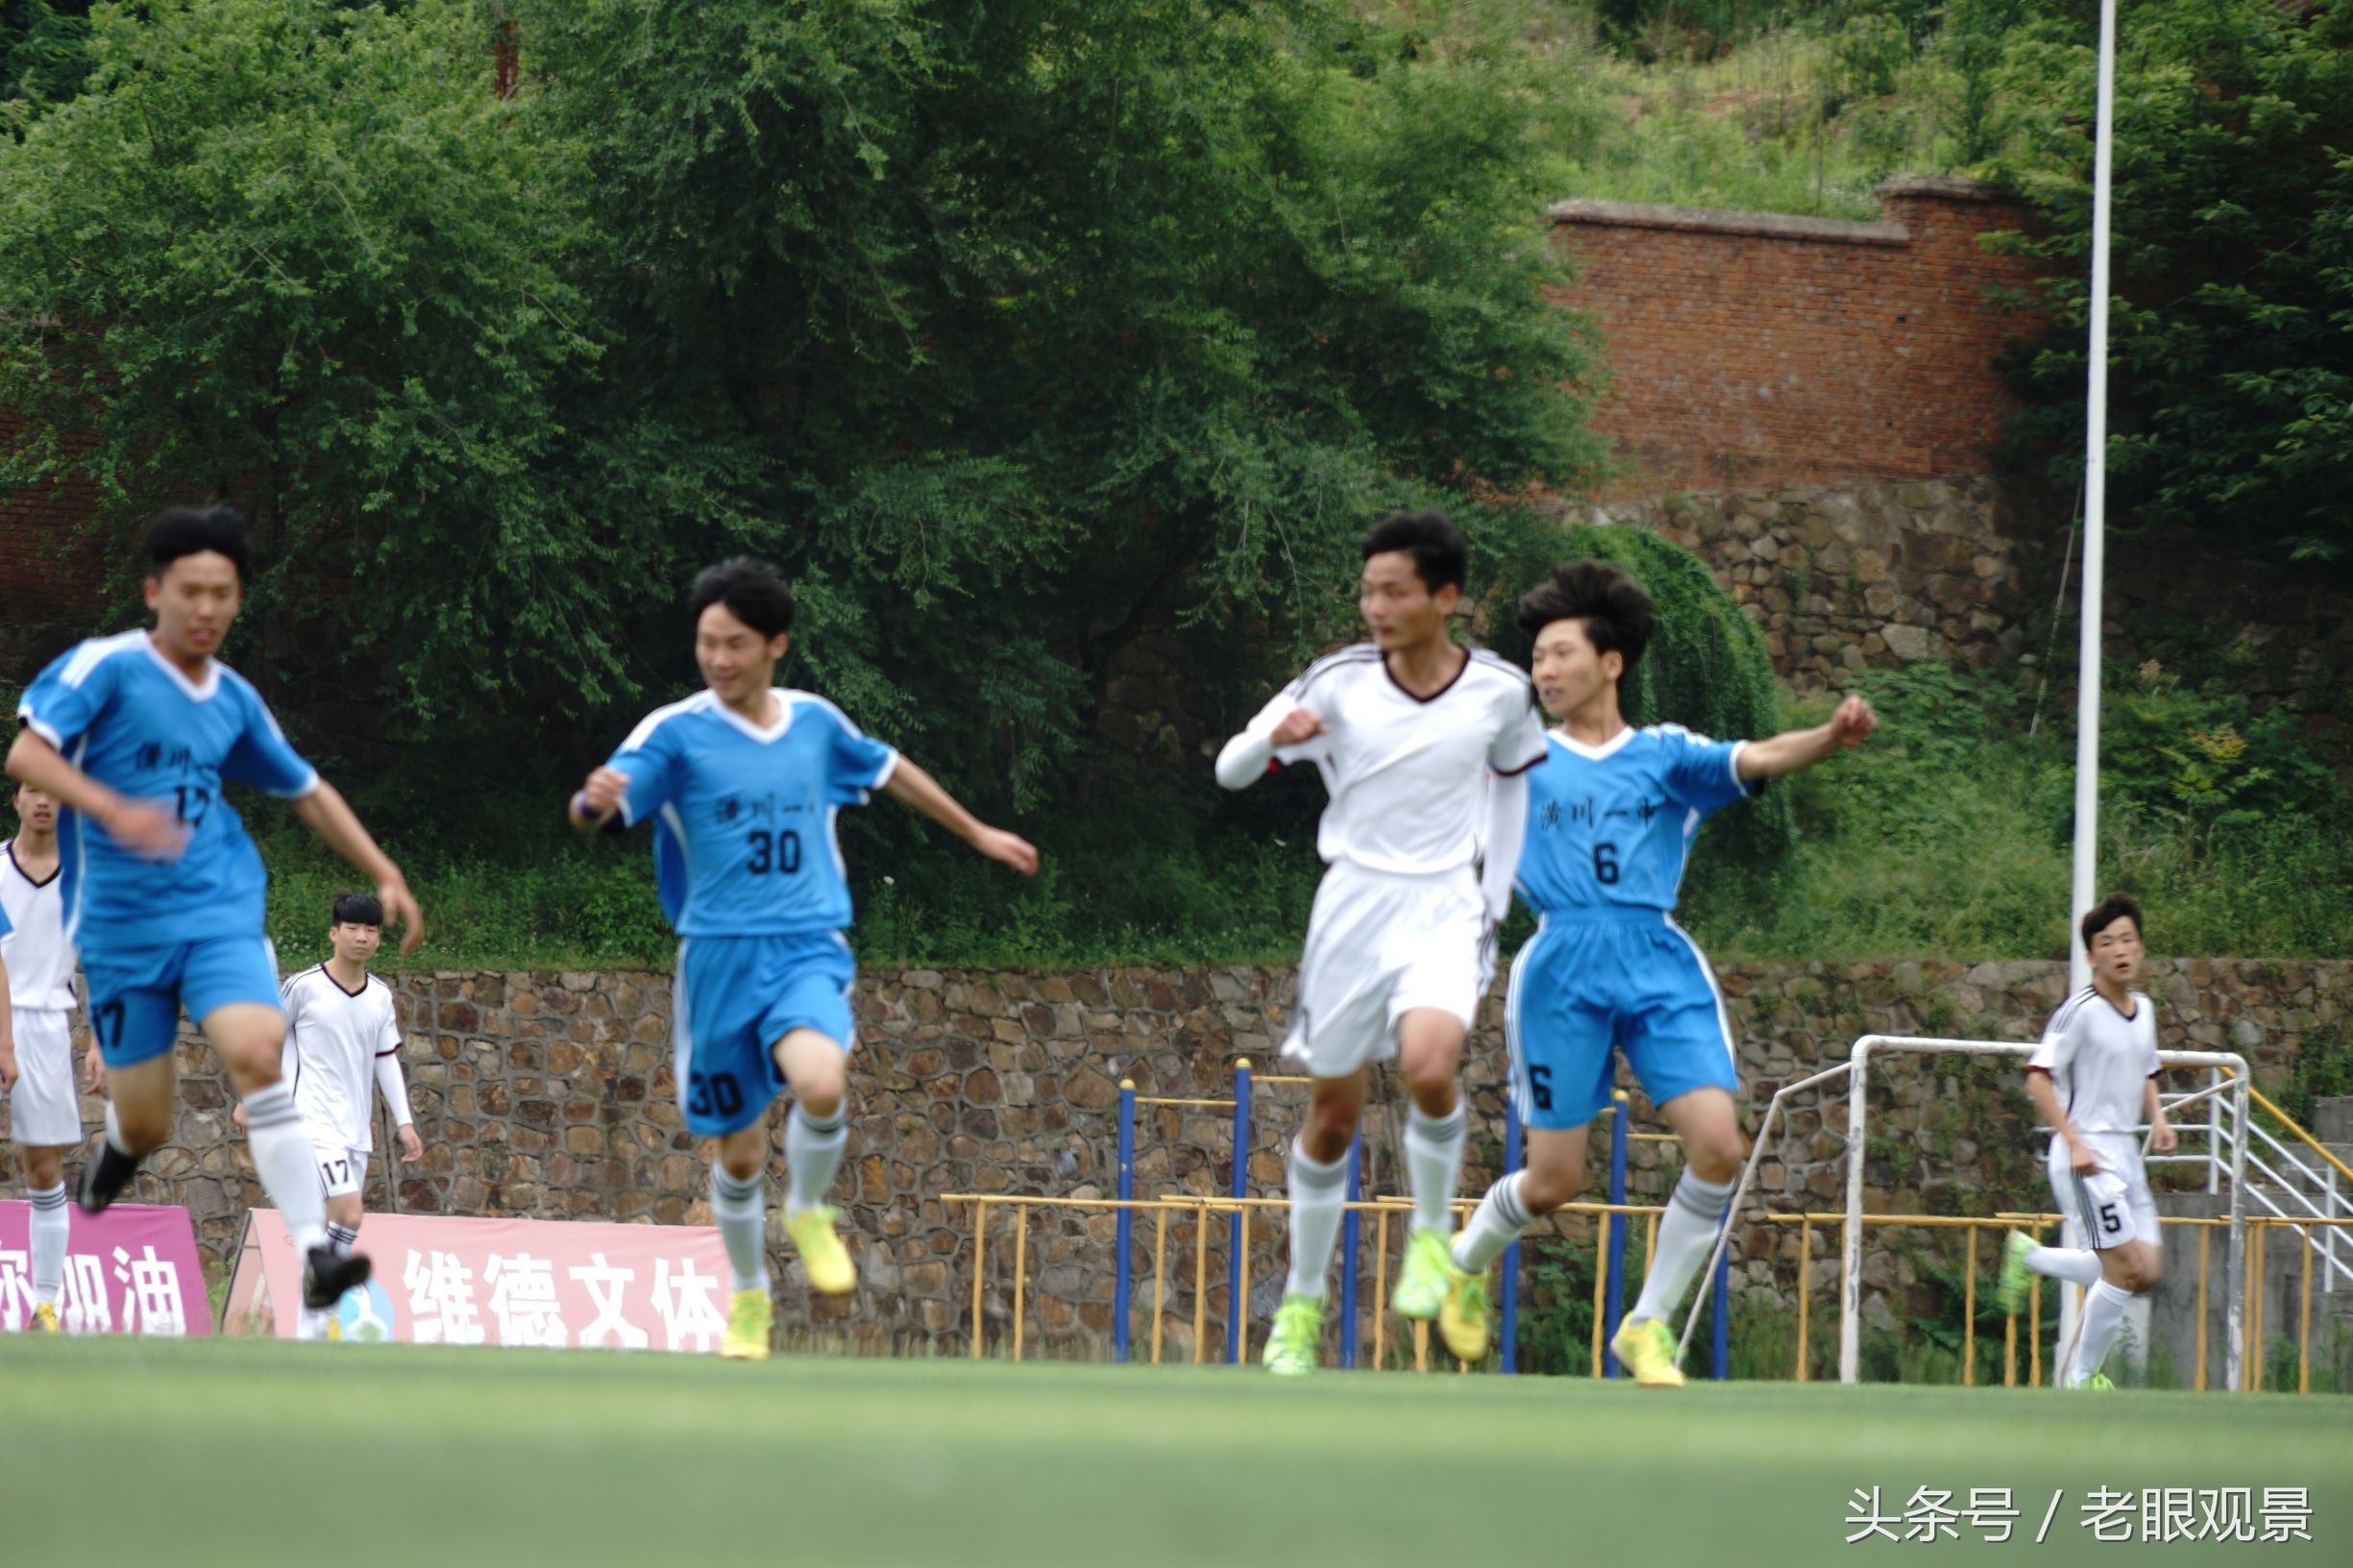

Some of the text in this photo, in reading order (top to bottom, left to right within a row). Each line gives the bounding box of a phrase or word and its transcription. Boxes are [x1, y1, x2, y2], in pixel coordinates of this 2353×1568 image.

[748, 830, 800, 874] 30
[1594, 843, 1619, 885] 6
[690, 1072, 744, 1117] 30
[1528, 1064, 1553, 1111] 6
[322, 1159, 349, 1186] 17
[2099, 1202, 2121, 1233] 5
[403, 1248, 728, 1352] 维德文体
